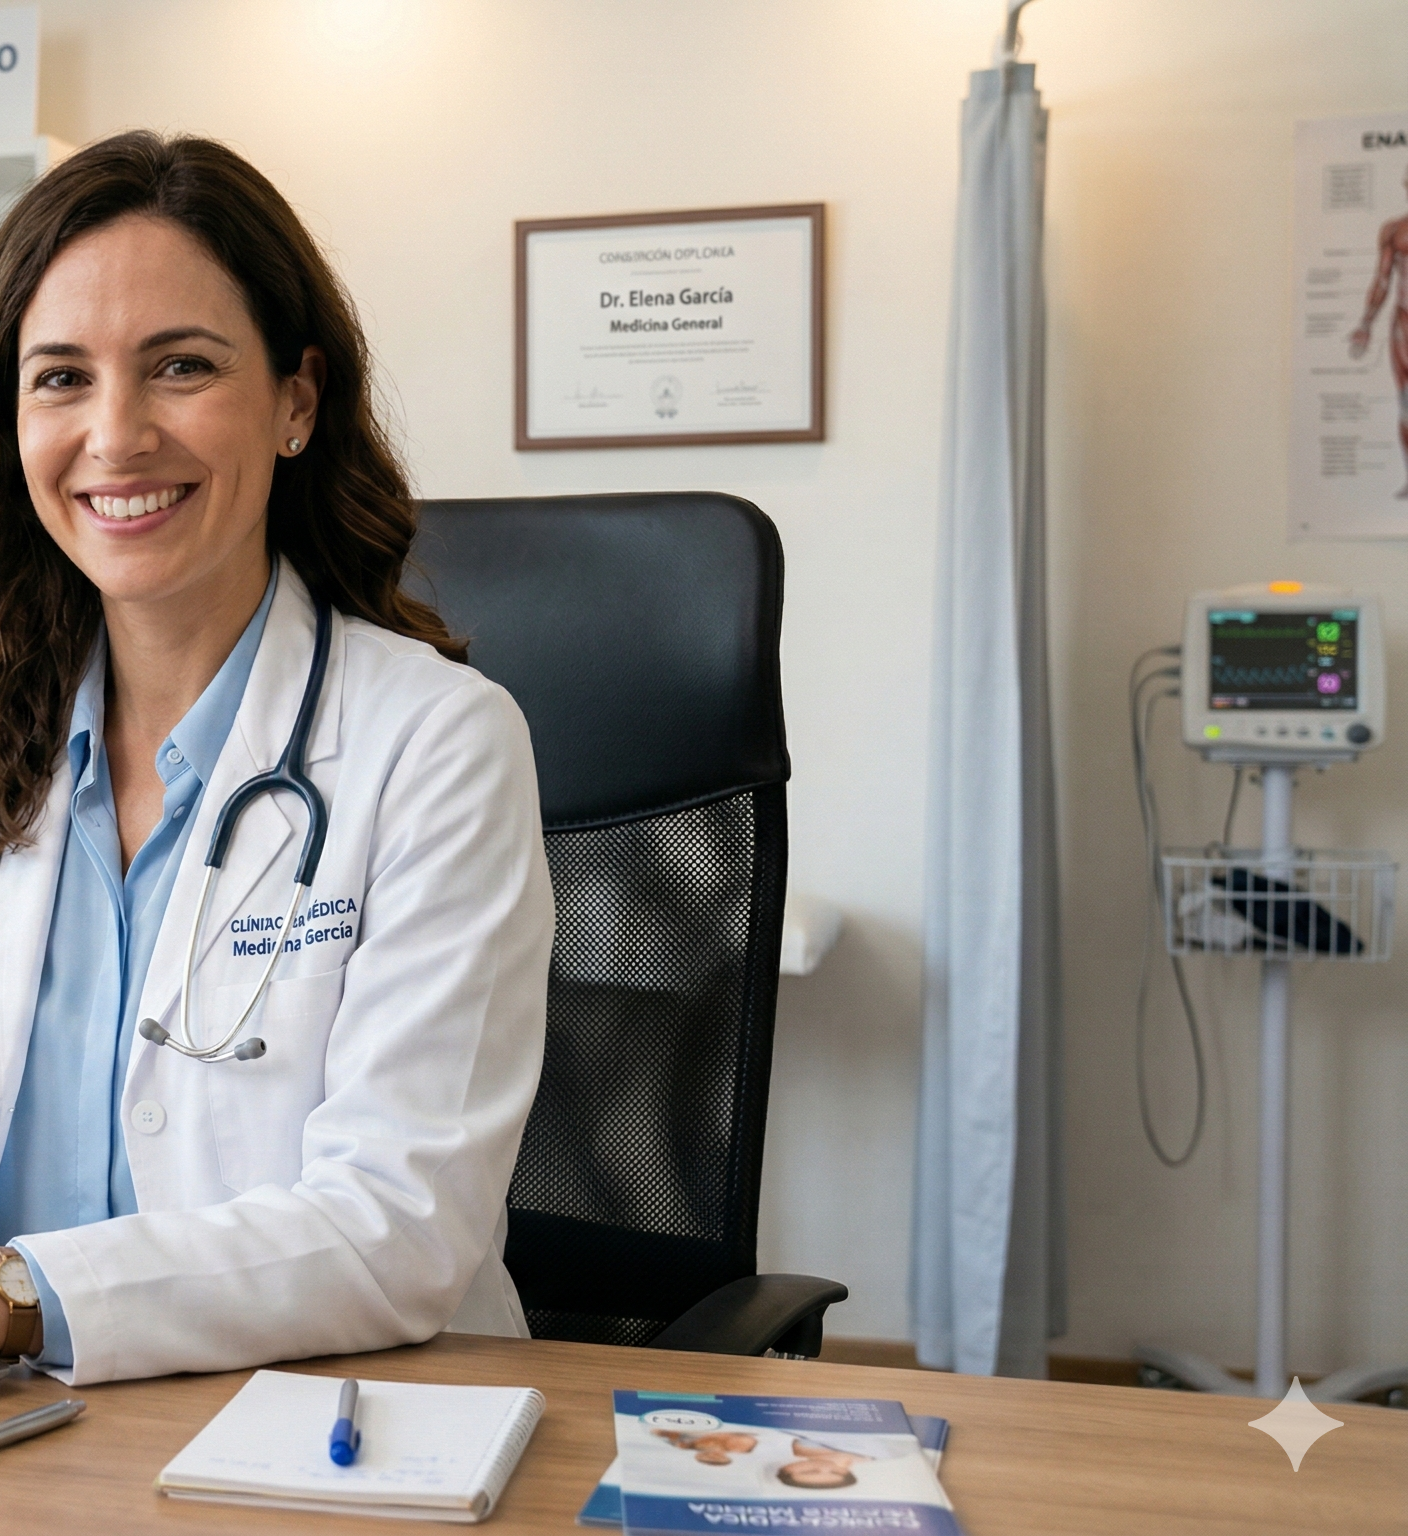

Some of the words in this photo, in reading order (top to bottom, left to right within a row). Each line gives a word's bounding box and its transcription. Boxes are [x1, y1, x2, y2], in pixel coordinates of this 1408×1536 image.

[600, 291, 624, 309] Dr.
[630, 289, 675, 308] Elena
[679, 286, 734, 306] García
[610, 319, 669, 333] Medicina
[672, 315, 723, 331] General
[233, 937, 302, 957] Medicna
